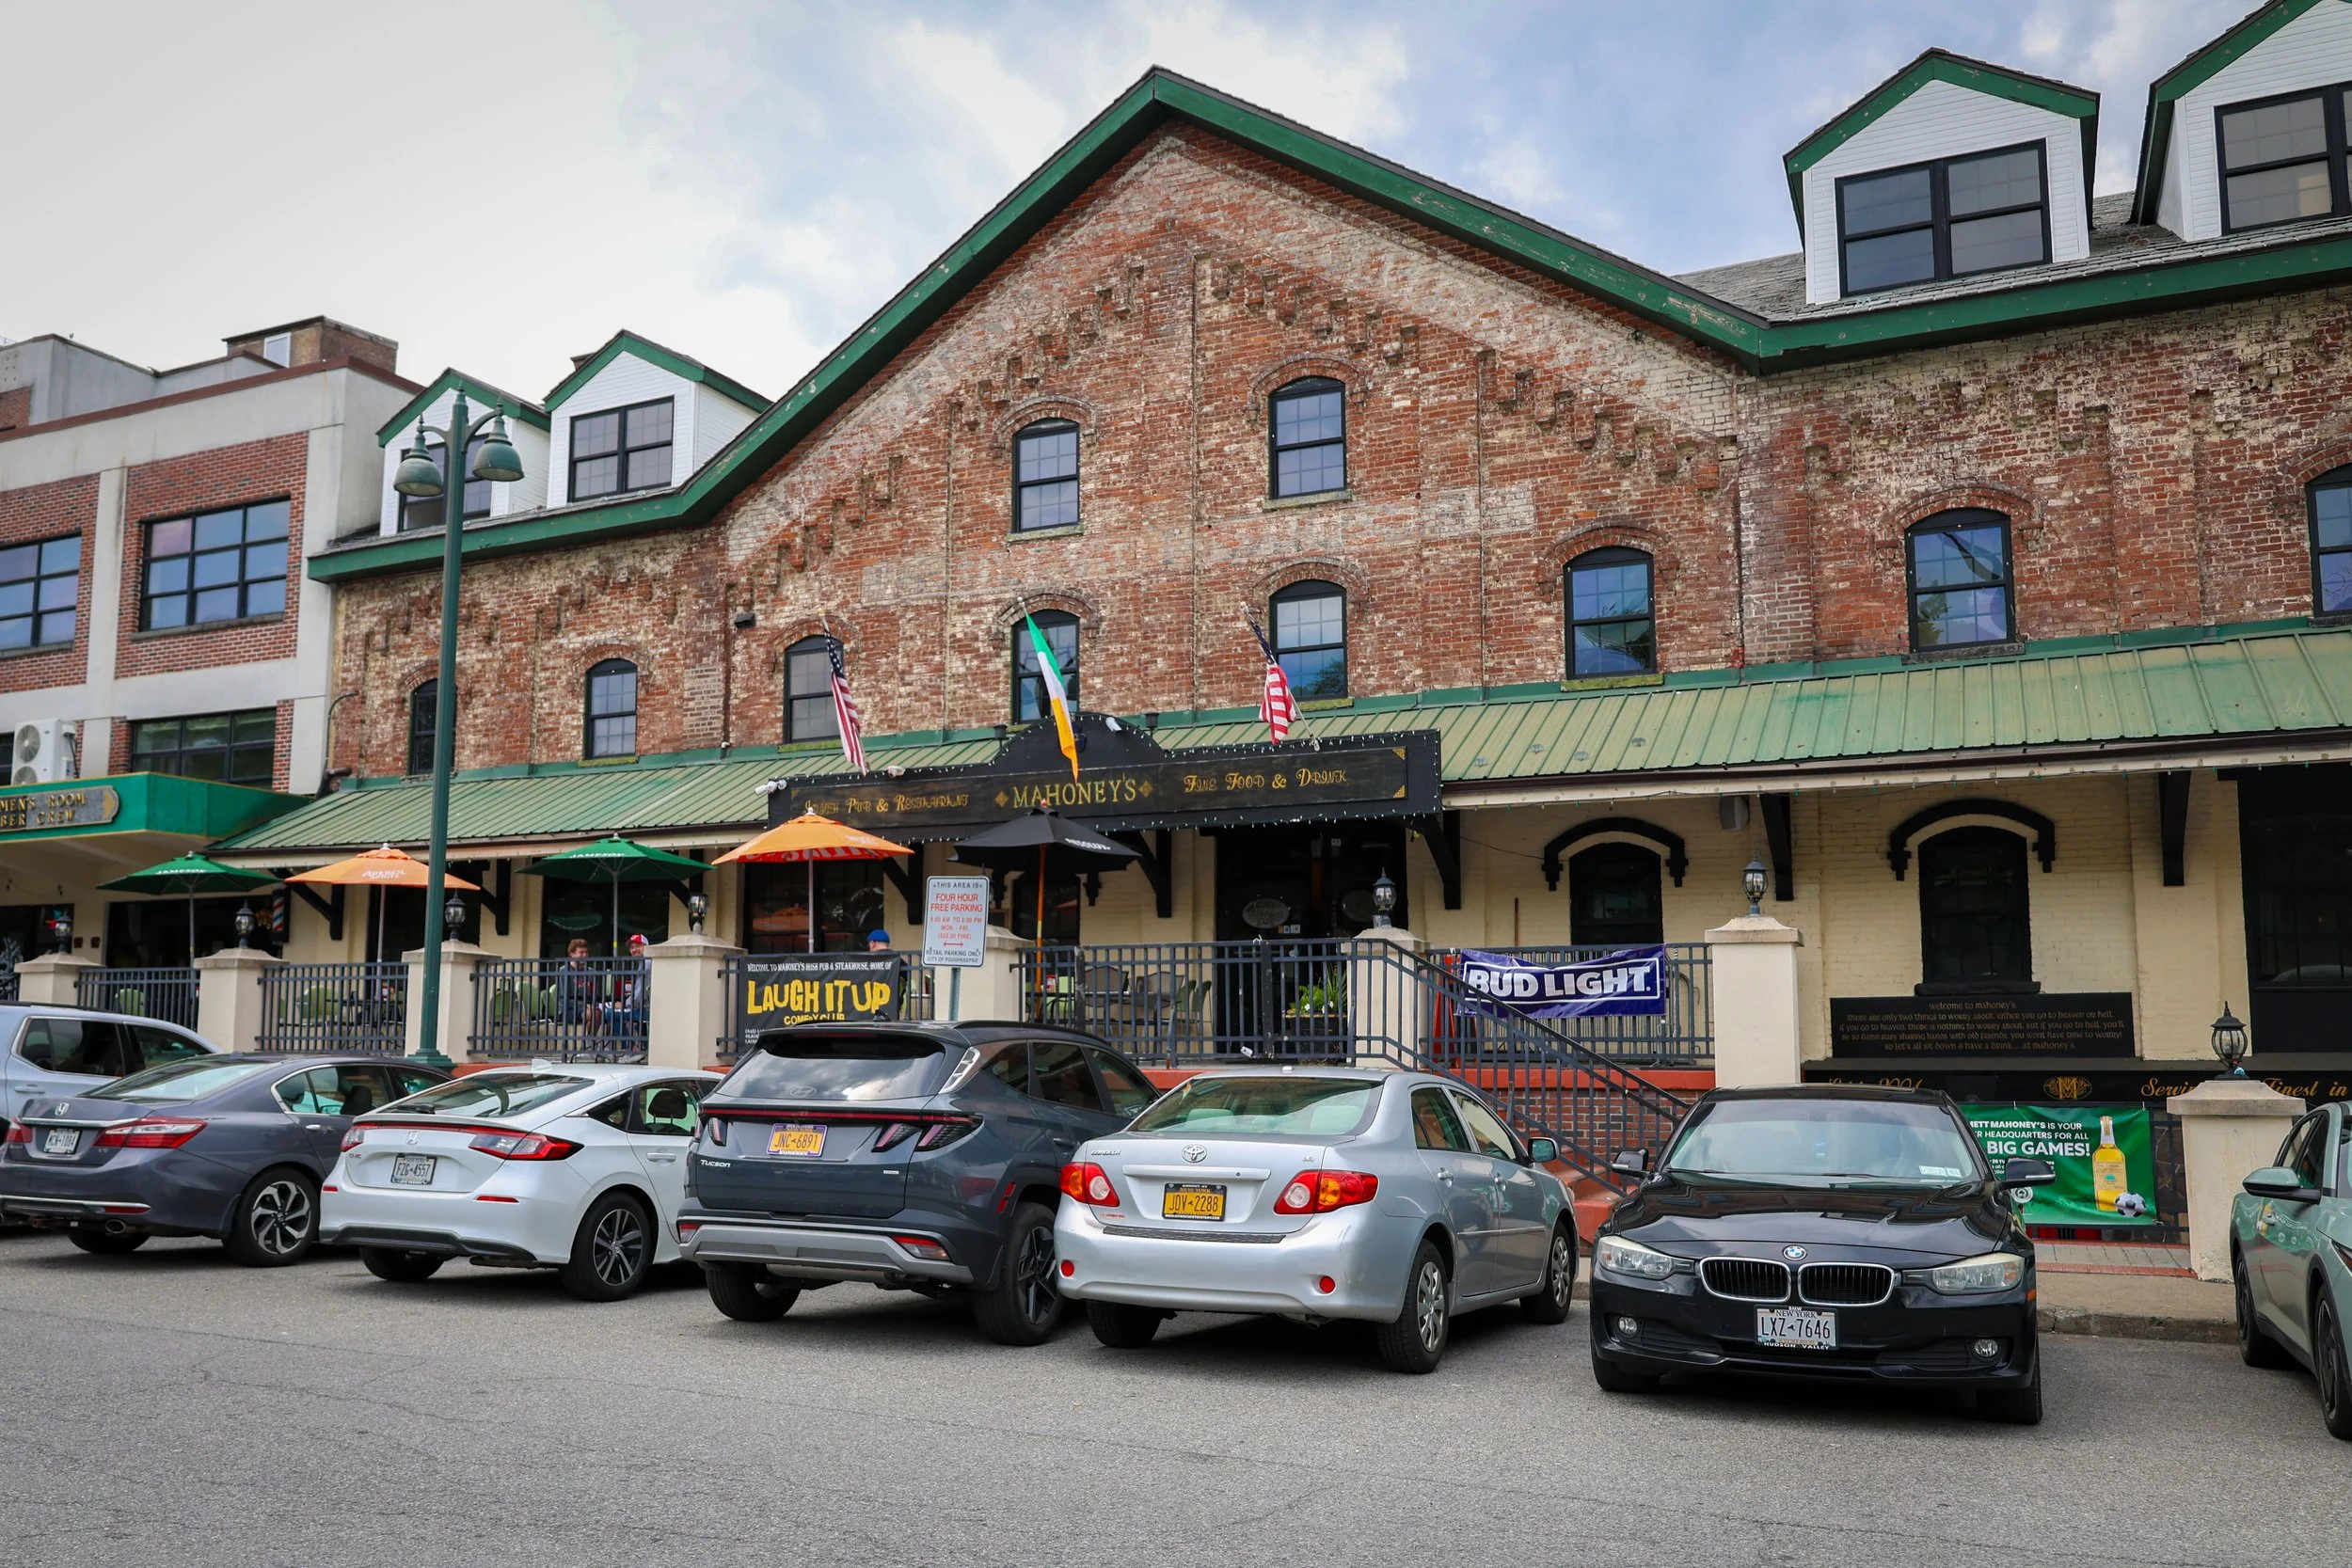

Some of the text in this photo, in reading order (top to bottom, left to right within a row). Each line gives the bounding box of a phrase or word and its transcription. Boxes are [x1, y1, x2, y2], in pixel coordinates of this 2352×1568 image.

[1272, 773, 1287, 789] &
[1012, 773, 1136, 808] MAHONEY'S
[47, 792, 87, 808] ROOM
[876, 798, 889, 813] &
[37, 809, 75, 826] CREW
[936, 893, 978, 902] FOUR HOUR
[930, 903, 983, 912] FREE PARKING
[777, 961, 804, 971] MAHONEY'S
[818, 962, 829, 971] PUB
[869, 961, 884, 970] HOME
[884, 961, 893, 970] OF
[1468, 966, 1651, 997] BUD LIGHT
[747, 979, 891, 1015] LAUGH IT UP
[2021, 1012, 2035, 1021] you
[1937, 1022, 1964, 1031] nothing
[2047, 1022, 2061, 1030] you
[2010, 1032, 2025, 1040] you
[2329, 1081, 2347, 1097] in
[1991, 1120, 2045, 1129] MAHONEY'S
[2058, 1122, 2082, 1131] YOUR
[1985, 1131, 2052, 1139] HEADQUARTERS
[2055, 1132, 2072, 1140] FOR
[1987, 1141, 2090, 1156] BIG GAMES!
